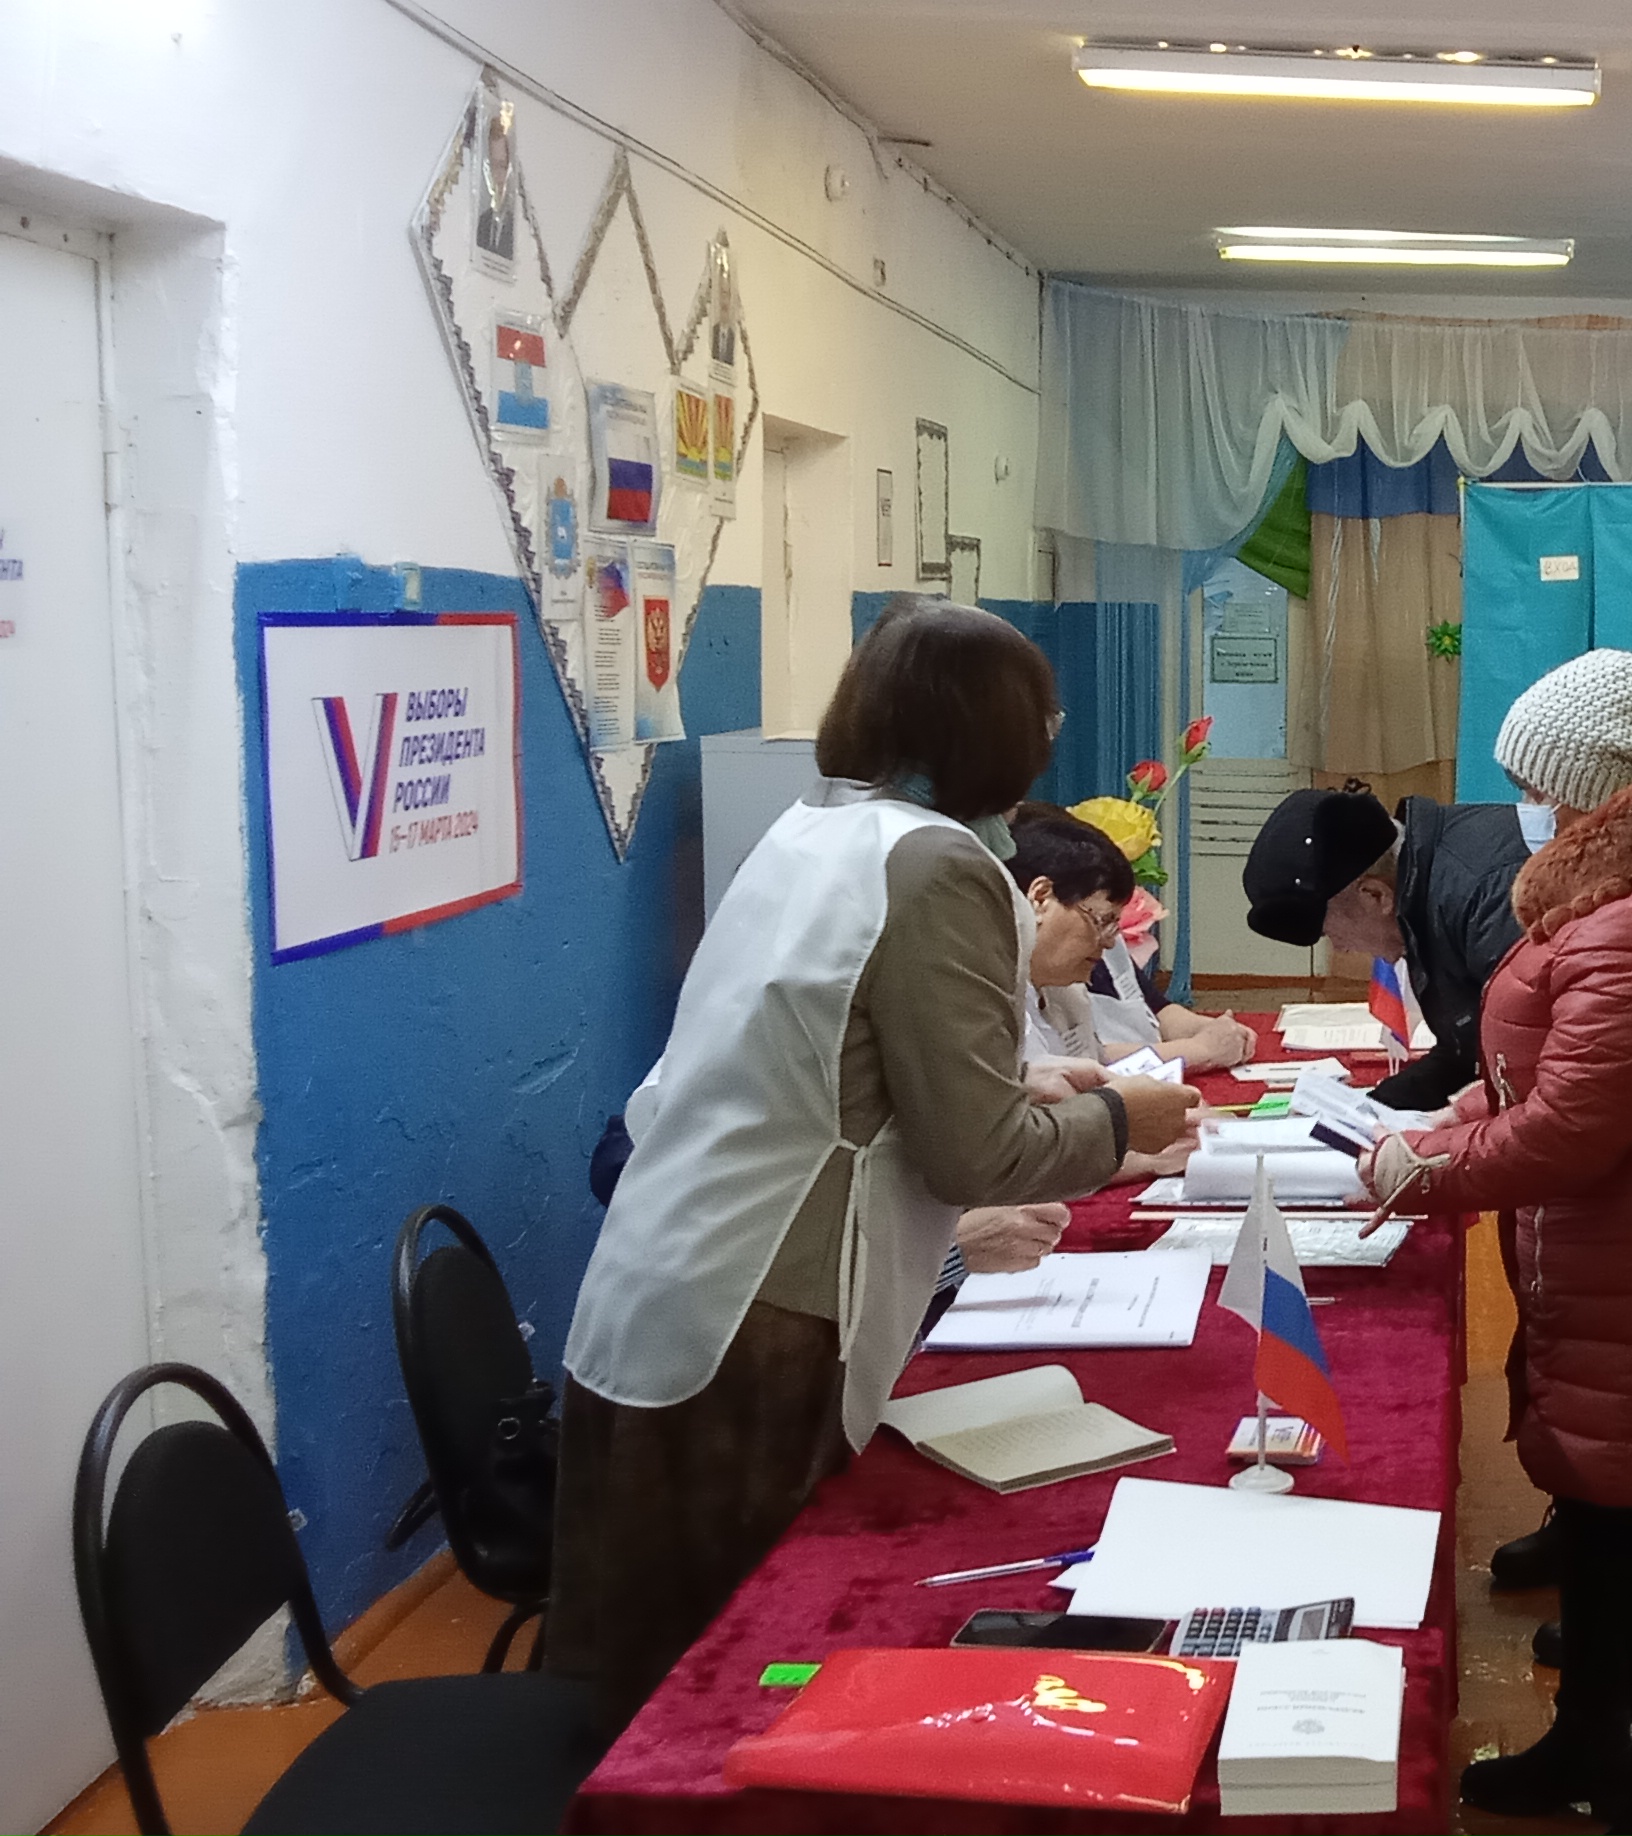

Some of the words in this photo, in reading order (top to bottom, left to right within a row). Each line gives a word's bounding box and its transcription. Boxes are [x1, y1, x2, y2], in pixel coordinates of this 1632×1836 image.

[406, 687, 468, 722] ВЫБОРЫ
[398, 727, 485, 767] ПРЕЗИДЕНТА
[392, 773, 451, 813] РОССИИ
[418, 815, 452, 846] МАРТА
[453, 810, 479, 838] 2024
